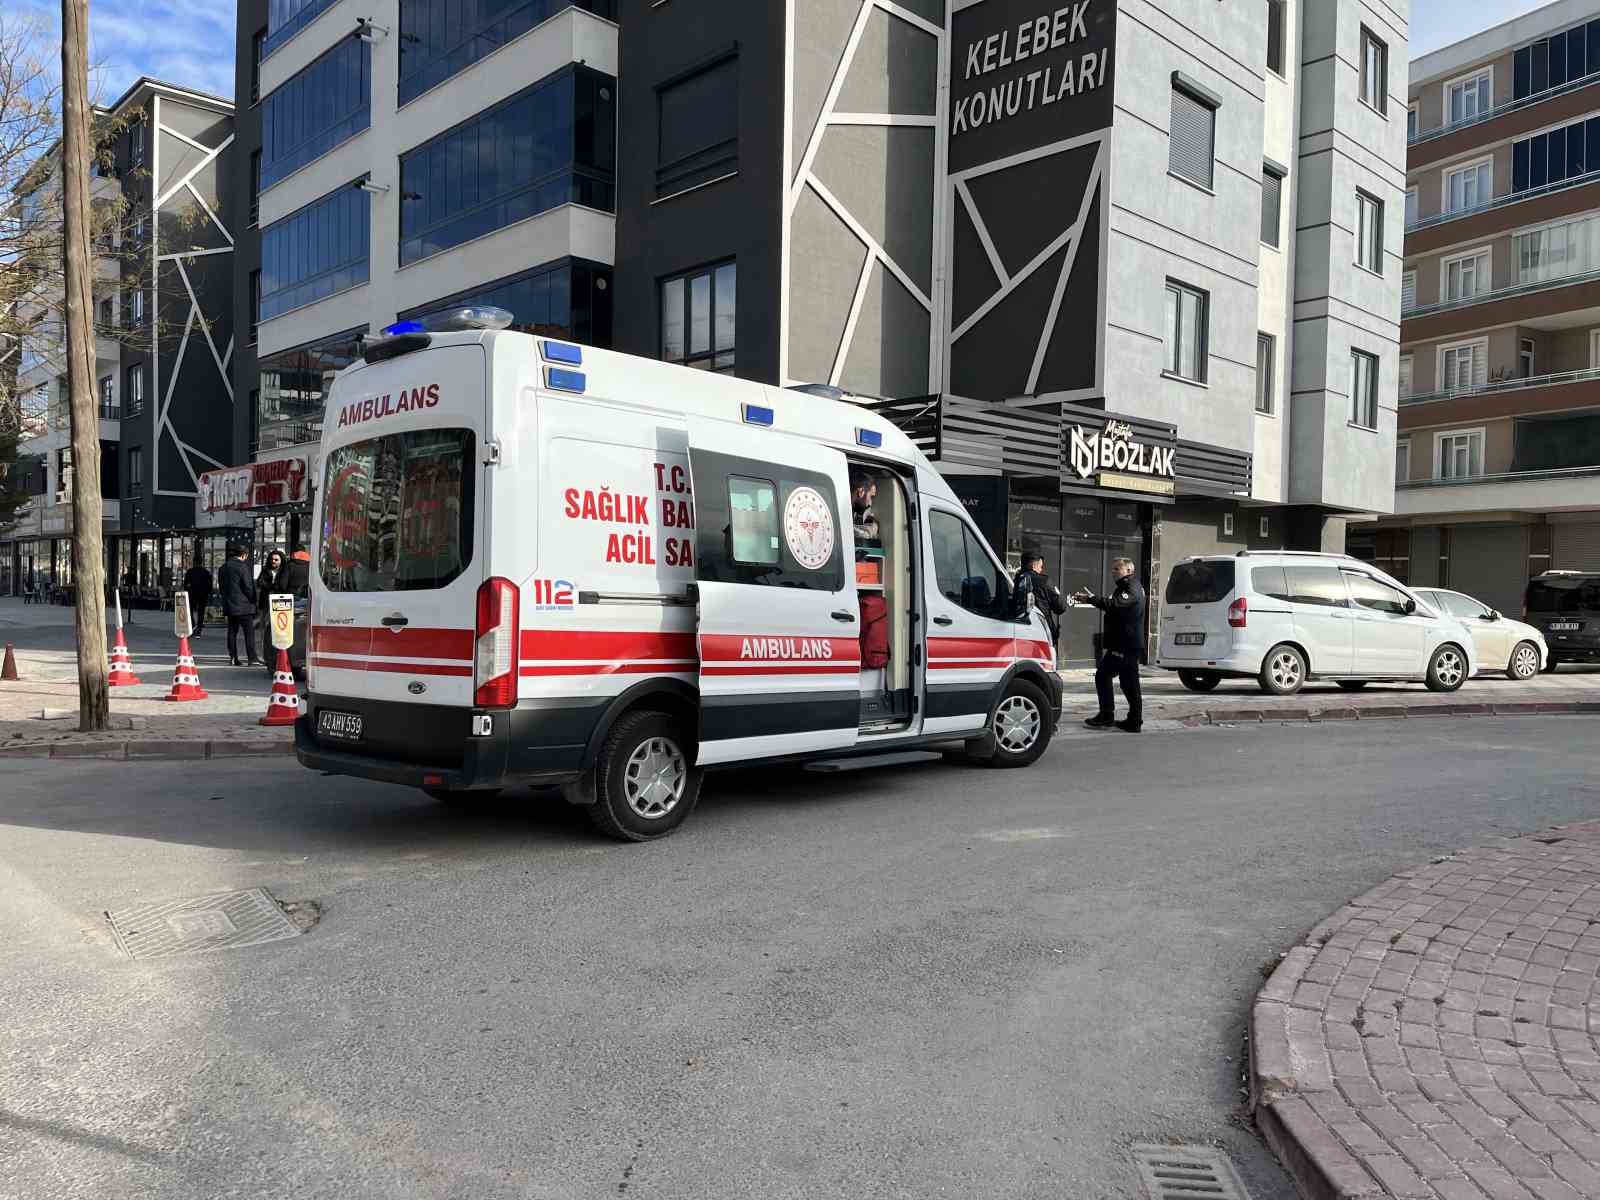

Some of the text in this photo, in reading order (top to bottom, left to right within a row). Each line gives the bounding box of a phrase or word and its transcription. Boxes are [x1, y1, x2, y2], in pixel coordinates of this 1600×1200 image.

[965, 0, 1090, 80] KELEBEK
[952, 47, 1108, 136] KONUTLARI
[338, 383, 440, 428] AMBULANS
[1101, 437, 1176, 477] BOZLAK
[654, 463, 692, 494] T.C.
[564, 484, 650, 526] SAĞLIK
[606, 530, 696, 568] ACİL SA
[534, 579, 574, 605] 112
[740, 637, 833, 659] AMBULANS
